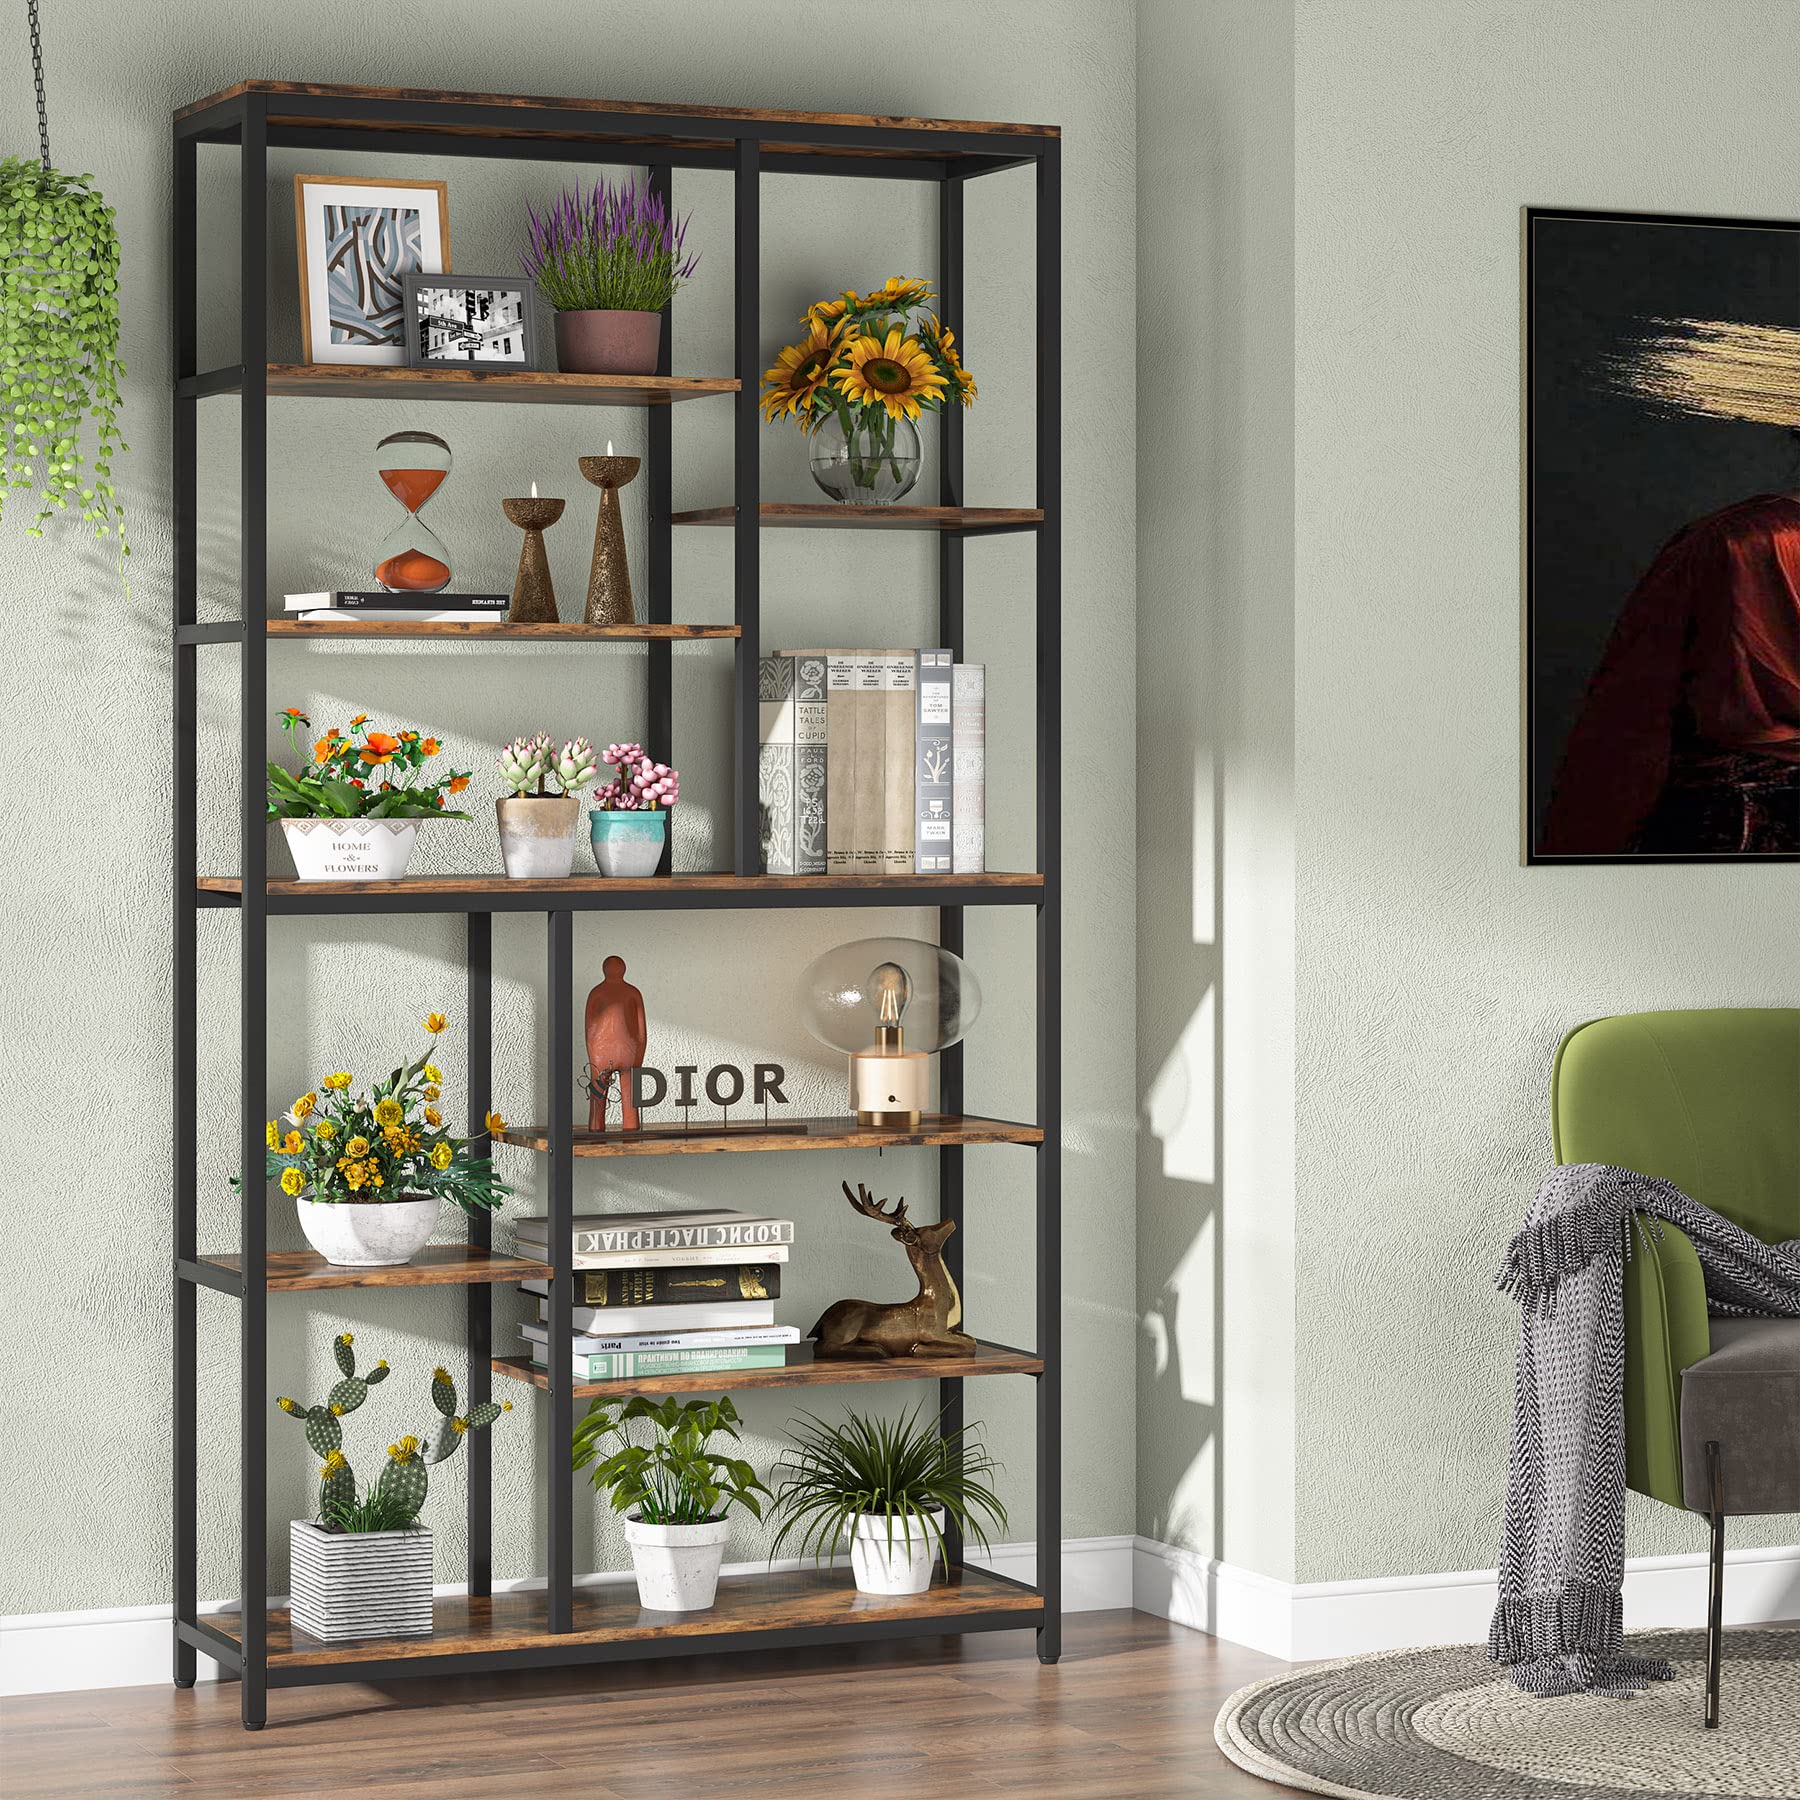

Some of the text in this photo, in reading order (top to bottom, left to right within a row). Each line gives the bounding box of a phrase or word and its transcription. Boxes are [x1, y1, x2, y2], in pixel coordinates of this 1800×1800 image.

[799, 706, 825, 714] TATTLE
[799, 716, 825, 724] TALES
[798, 732, 826, 740] CUPID
[332, 842, 371, 851] HOME
[324, 864, 379, 873] FLOWERS
[631, 1063, 790, 1108] DIOR
[585, 1224, 782, 1252] БОРИС ПАСТЕРНАК
[638, 1352, 680, 1363] ПРАКТИКУМ
[681, 1352, 690, 1361] ПО
